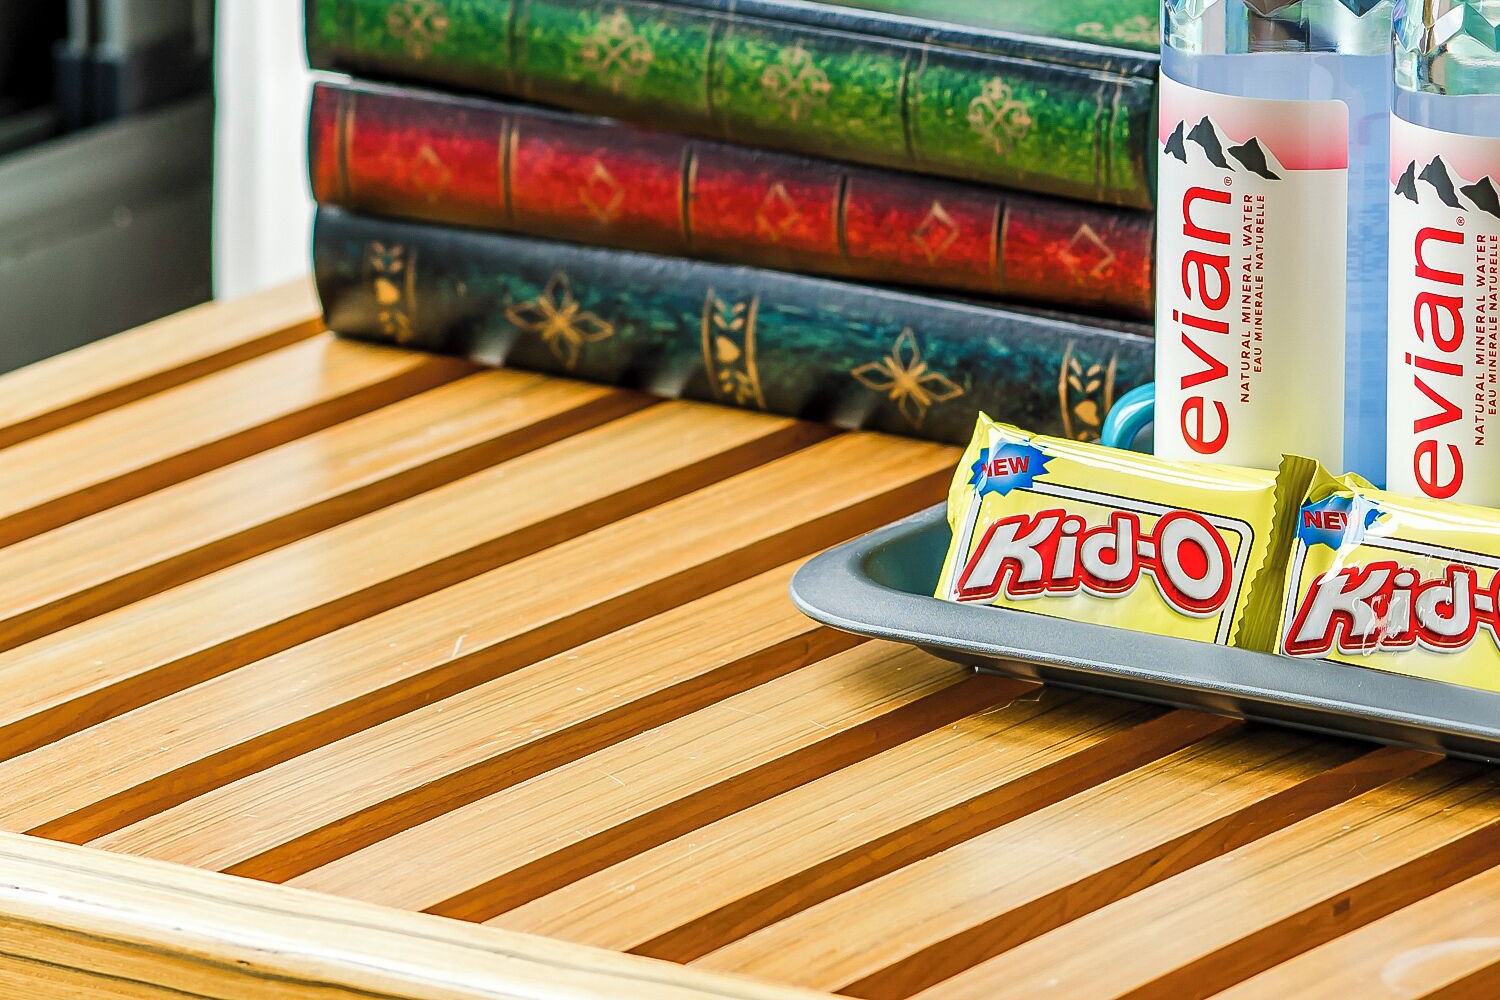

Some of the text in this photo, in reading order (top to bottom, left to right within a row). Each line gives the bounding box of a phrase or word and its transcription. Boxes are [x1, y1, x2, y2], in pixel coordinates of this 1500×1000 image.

[1240, 194, 1253, 403] NATURAL MINERAL WATER
[1254, 195, 1265, 373] EAU MINERALE NATURELLE
[1475, 234, 1487, 446] NATURAL MINERAL WATER
[1488, 234, 1498, 415] EAU MINERALE NATURELLE
[955, 510, 1232, 615] Kid-O
